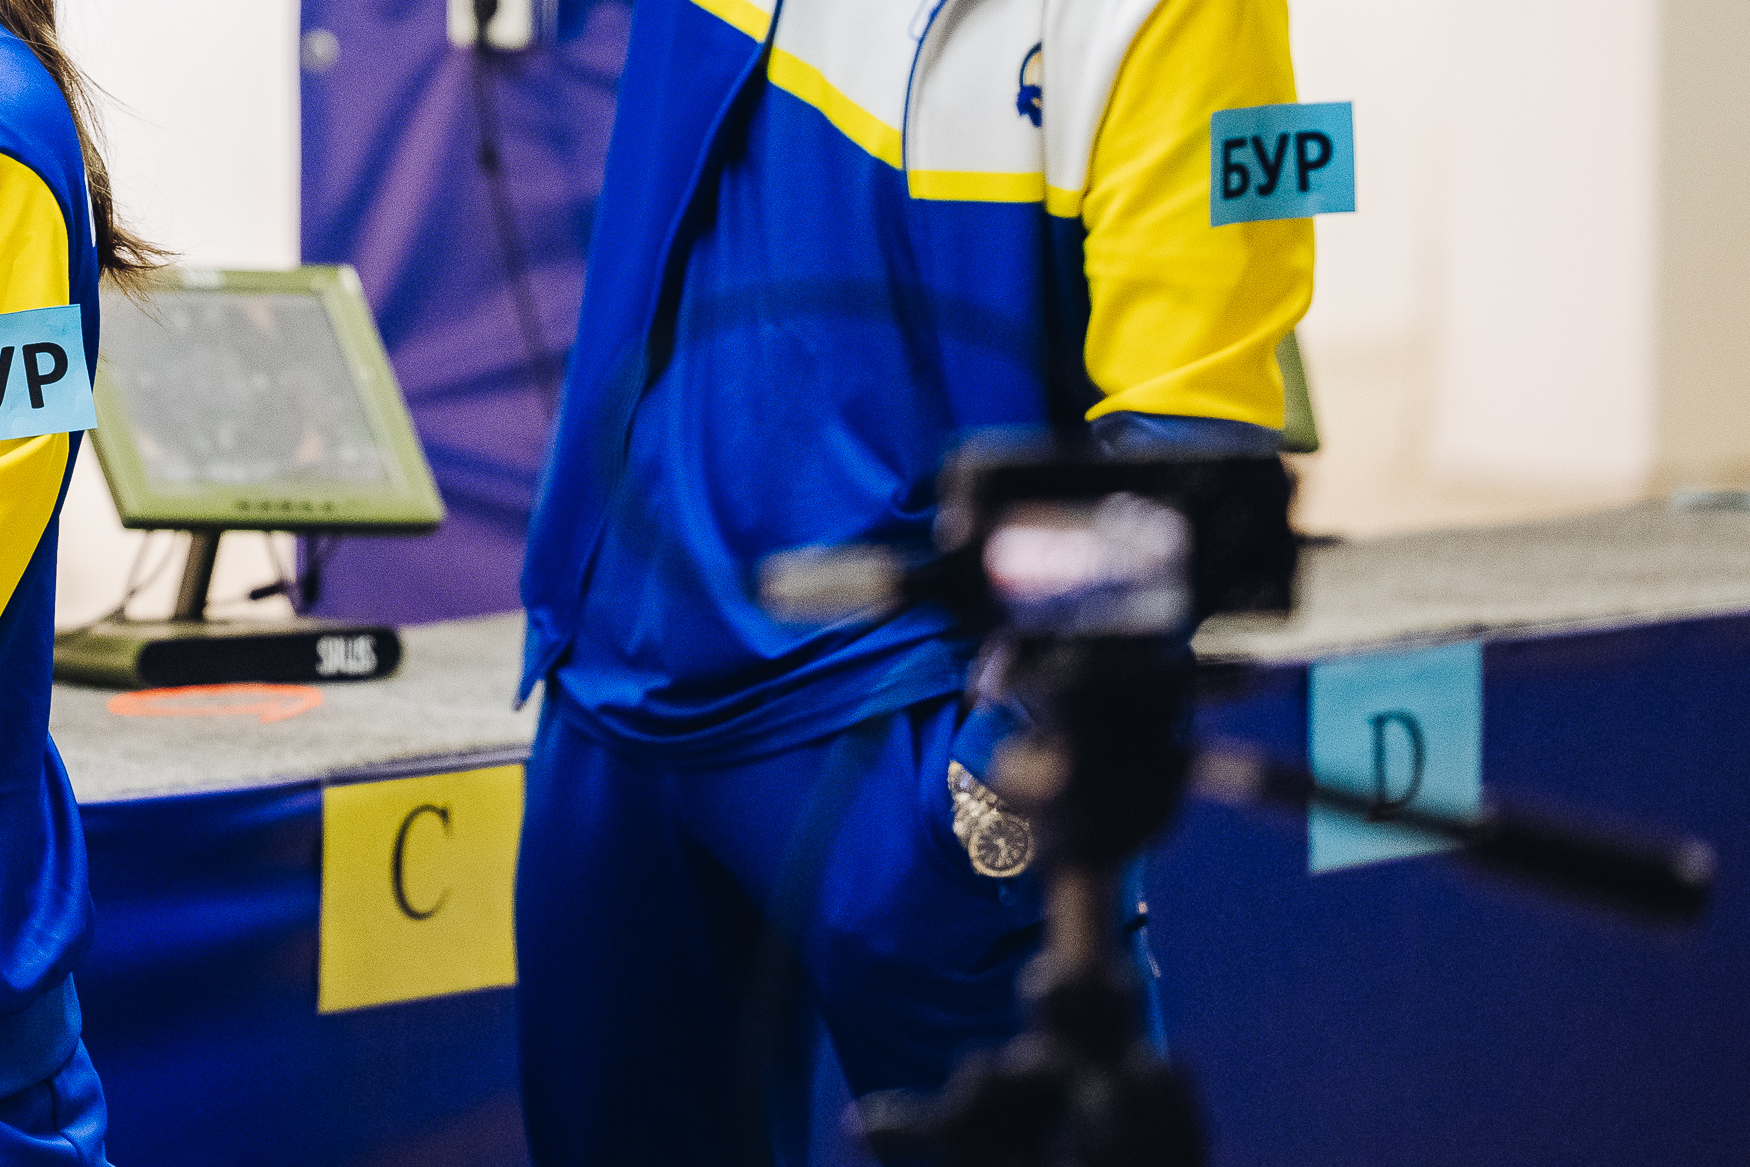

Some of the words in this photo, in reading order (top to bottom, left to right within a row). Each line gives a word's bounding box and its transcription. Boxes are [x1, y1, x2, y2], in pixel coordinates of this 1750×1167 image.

[1220, 130, 1332, 200] БУР
[1367, 711, 1426, 822] D
[391, 804, 452, 921] C
